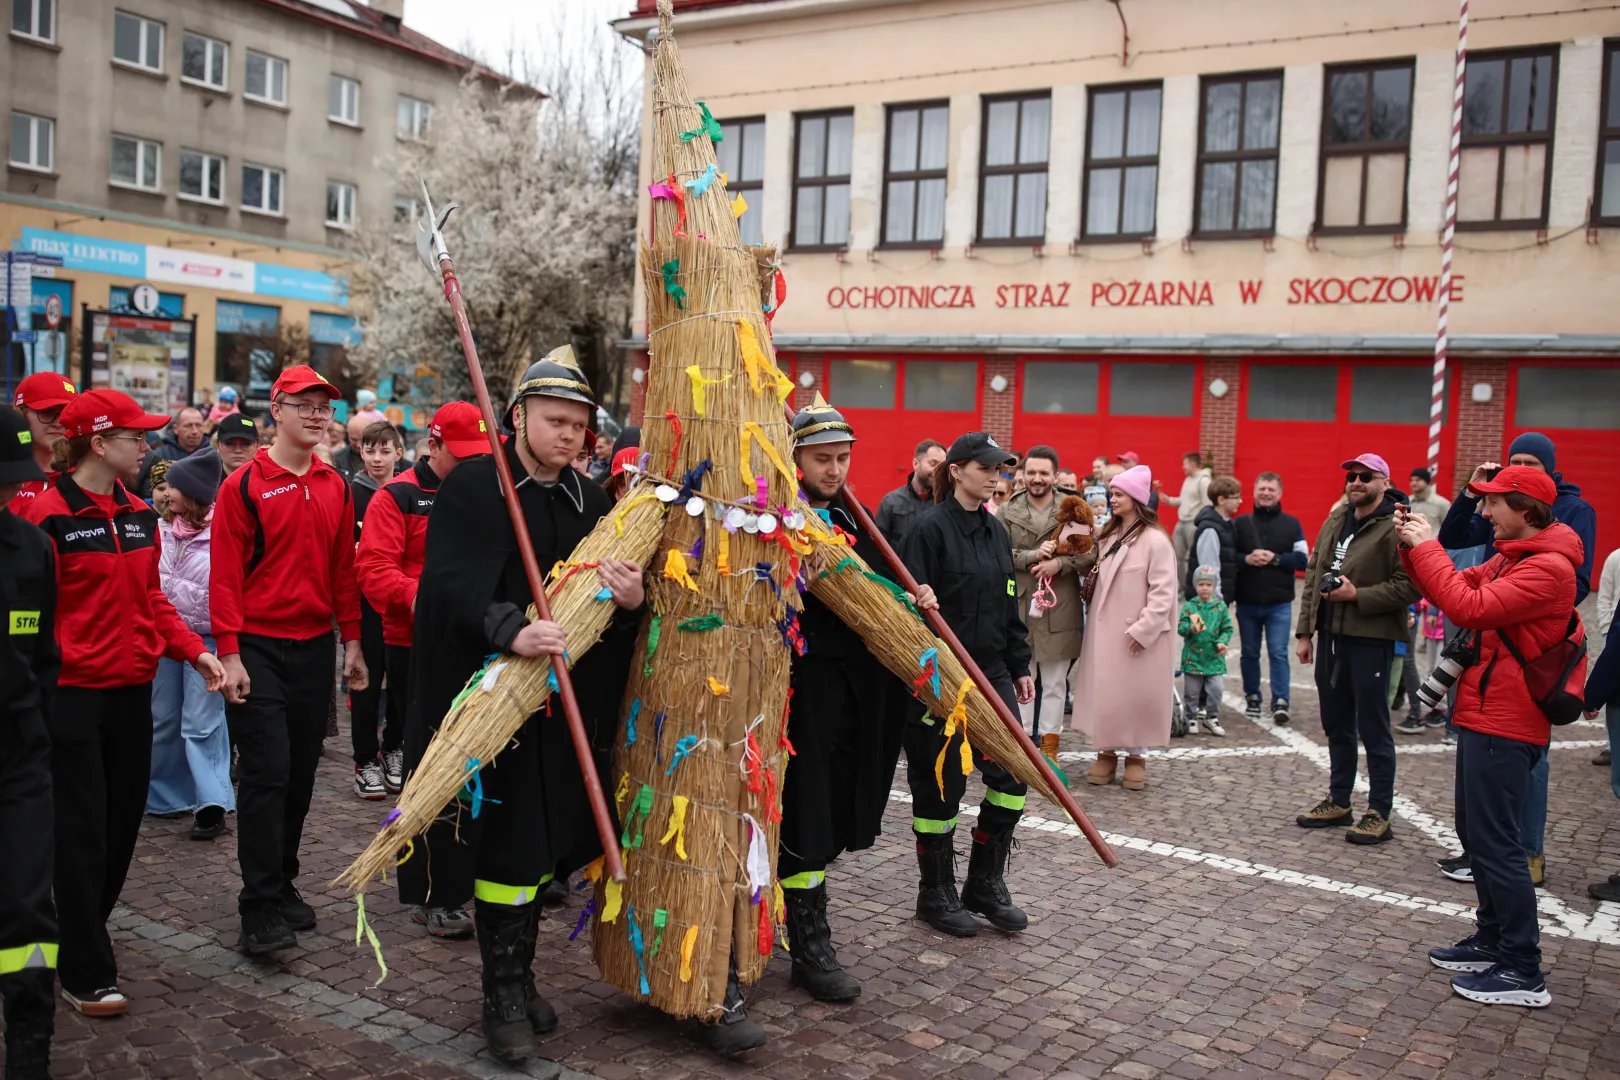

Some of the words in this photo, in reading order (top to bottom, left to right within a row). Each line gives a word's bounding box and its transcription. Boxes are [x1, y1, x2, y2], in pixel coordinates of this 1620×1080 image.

[31, 237, 70, 257] max
[73, 243, 140, 266] ELEKTRO
[827, 285, 976, 309] OCHOTNICZA
[996, 281, 1071, 308] STRAŻ
[1091, 279, 1214, 307] POŻARNA
[1239, 279, 1262, 304] W
[1287, 275, 1465, 304] SKOCZOWE
[261, 483, 298, 499] GIVOVA
[65, 527, 106, 542] GIVOVA
